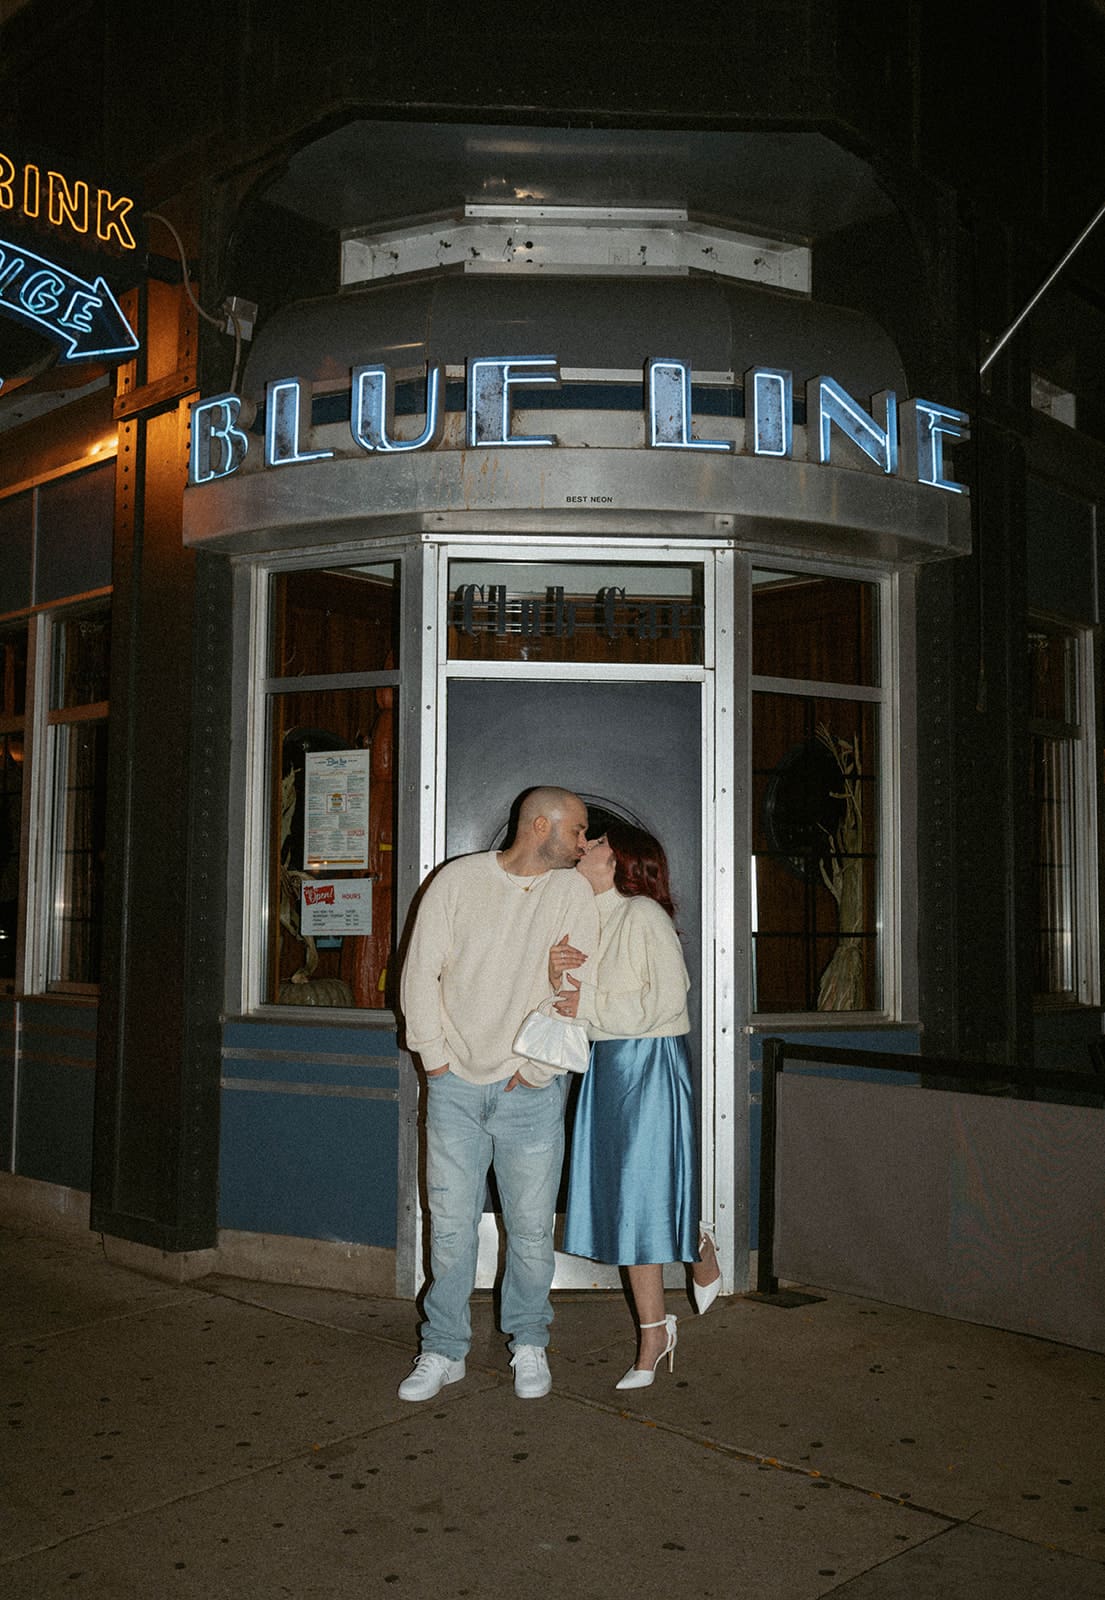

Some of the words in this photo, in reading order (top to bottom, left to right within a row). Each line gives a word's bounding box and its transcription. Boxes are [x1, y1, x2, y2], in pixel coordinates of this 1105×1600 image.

[188, 355, 558, 486] BLUE
[645, 358, 971, 497] LINE
[566, 495, 587, 503] BEST
[456, 584, 576, 639] Club
[603, 586, 690, 640] Car
